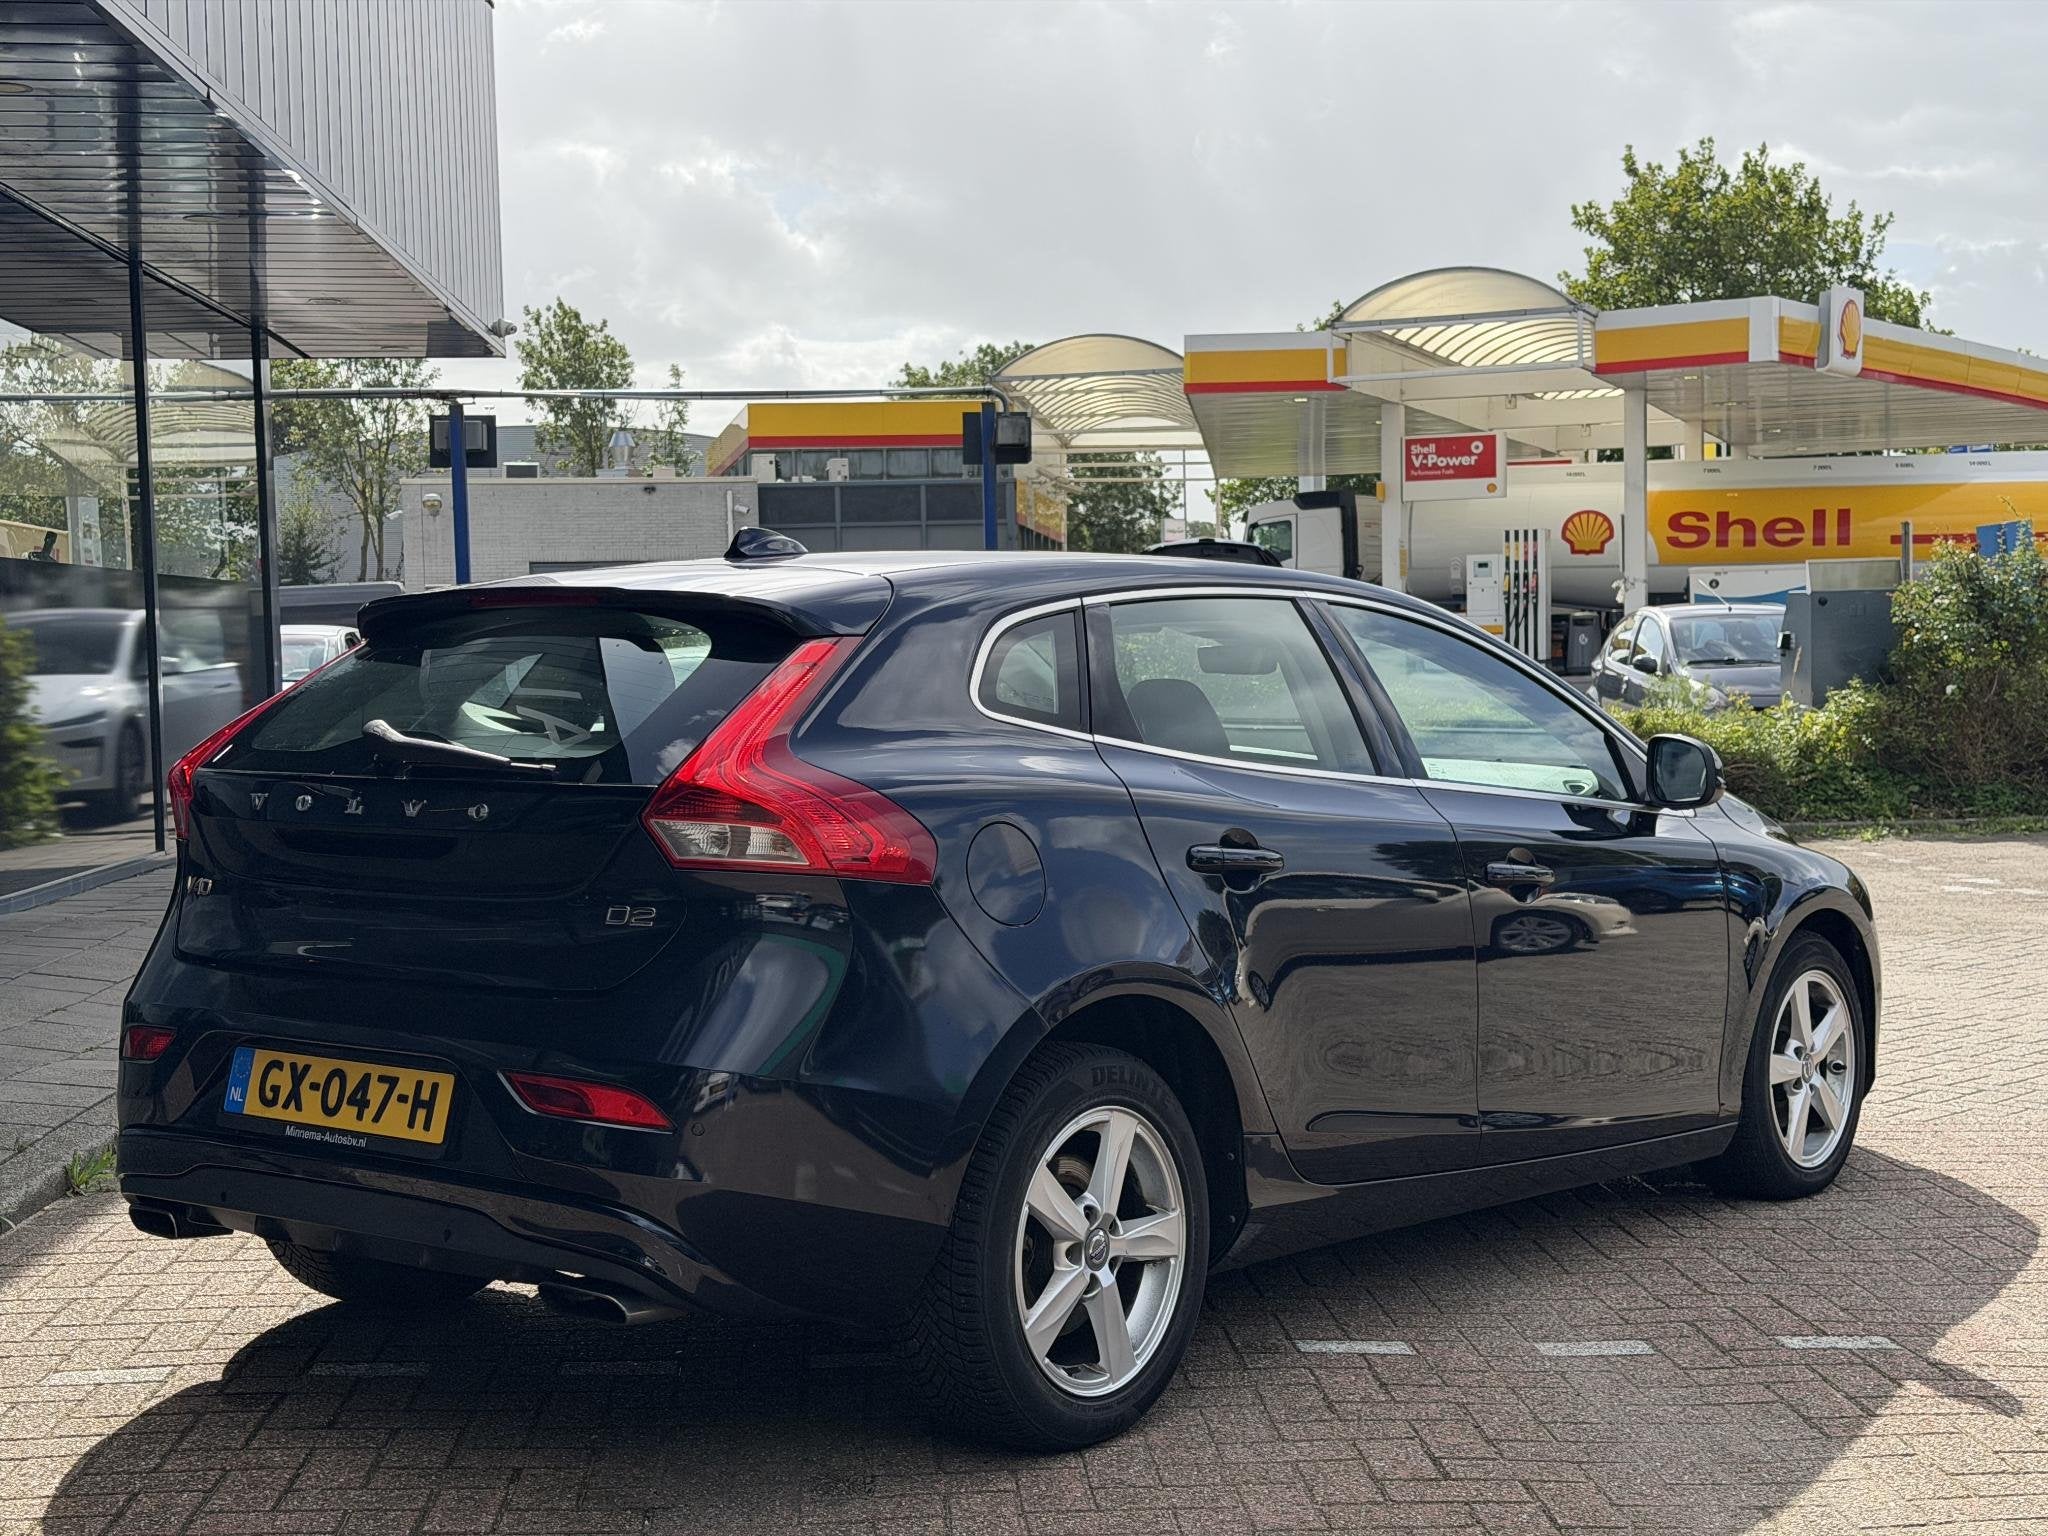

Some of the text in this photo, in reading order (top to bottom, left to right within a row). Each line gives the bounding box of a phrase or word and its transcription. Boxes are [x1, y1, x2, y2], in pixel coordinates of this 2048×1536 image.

[1410, 443, 1436, 455] Shell
[1411, 454, 1478, 468] V-Power
[1666, 508, 1851, 549] Shell
[250, 793, 489, 822] VOLVO
[605, 905, 656, 927] D2
[230, 1086, 243, 1102] NL
[258, 1059, 440, 1132] GX-047-H
[285, 1124, 367, 1149] Minnema-Autosbv.nl
